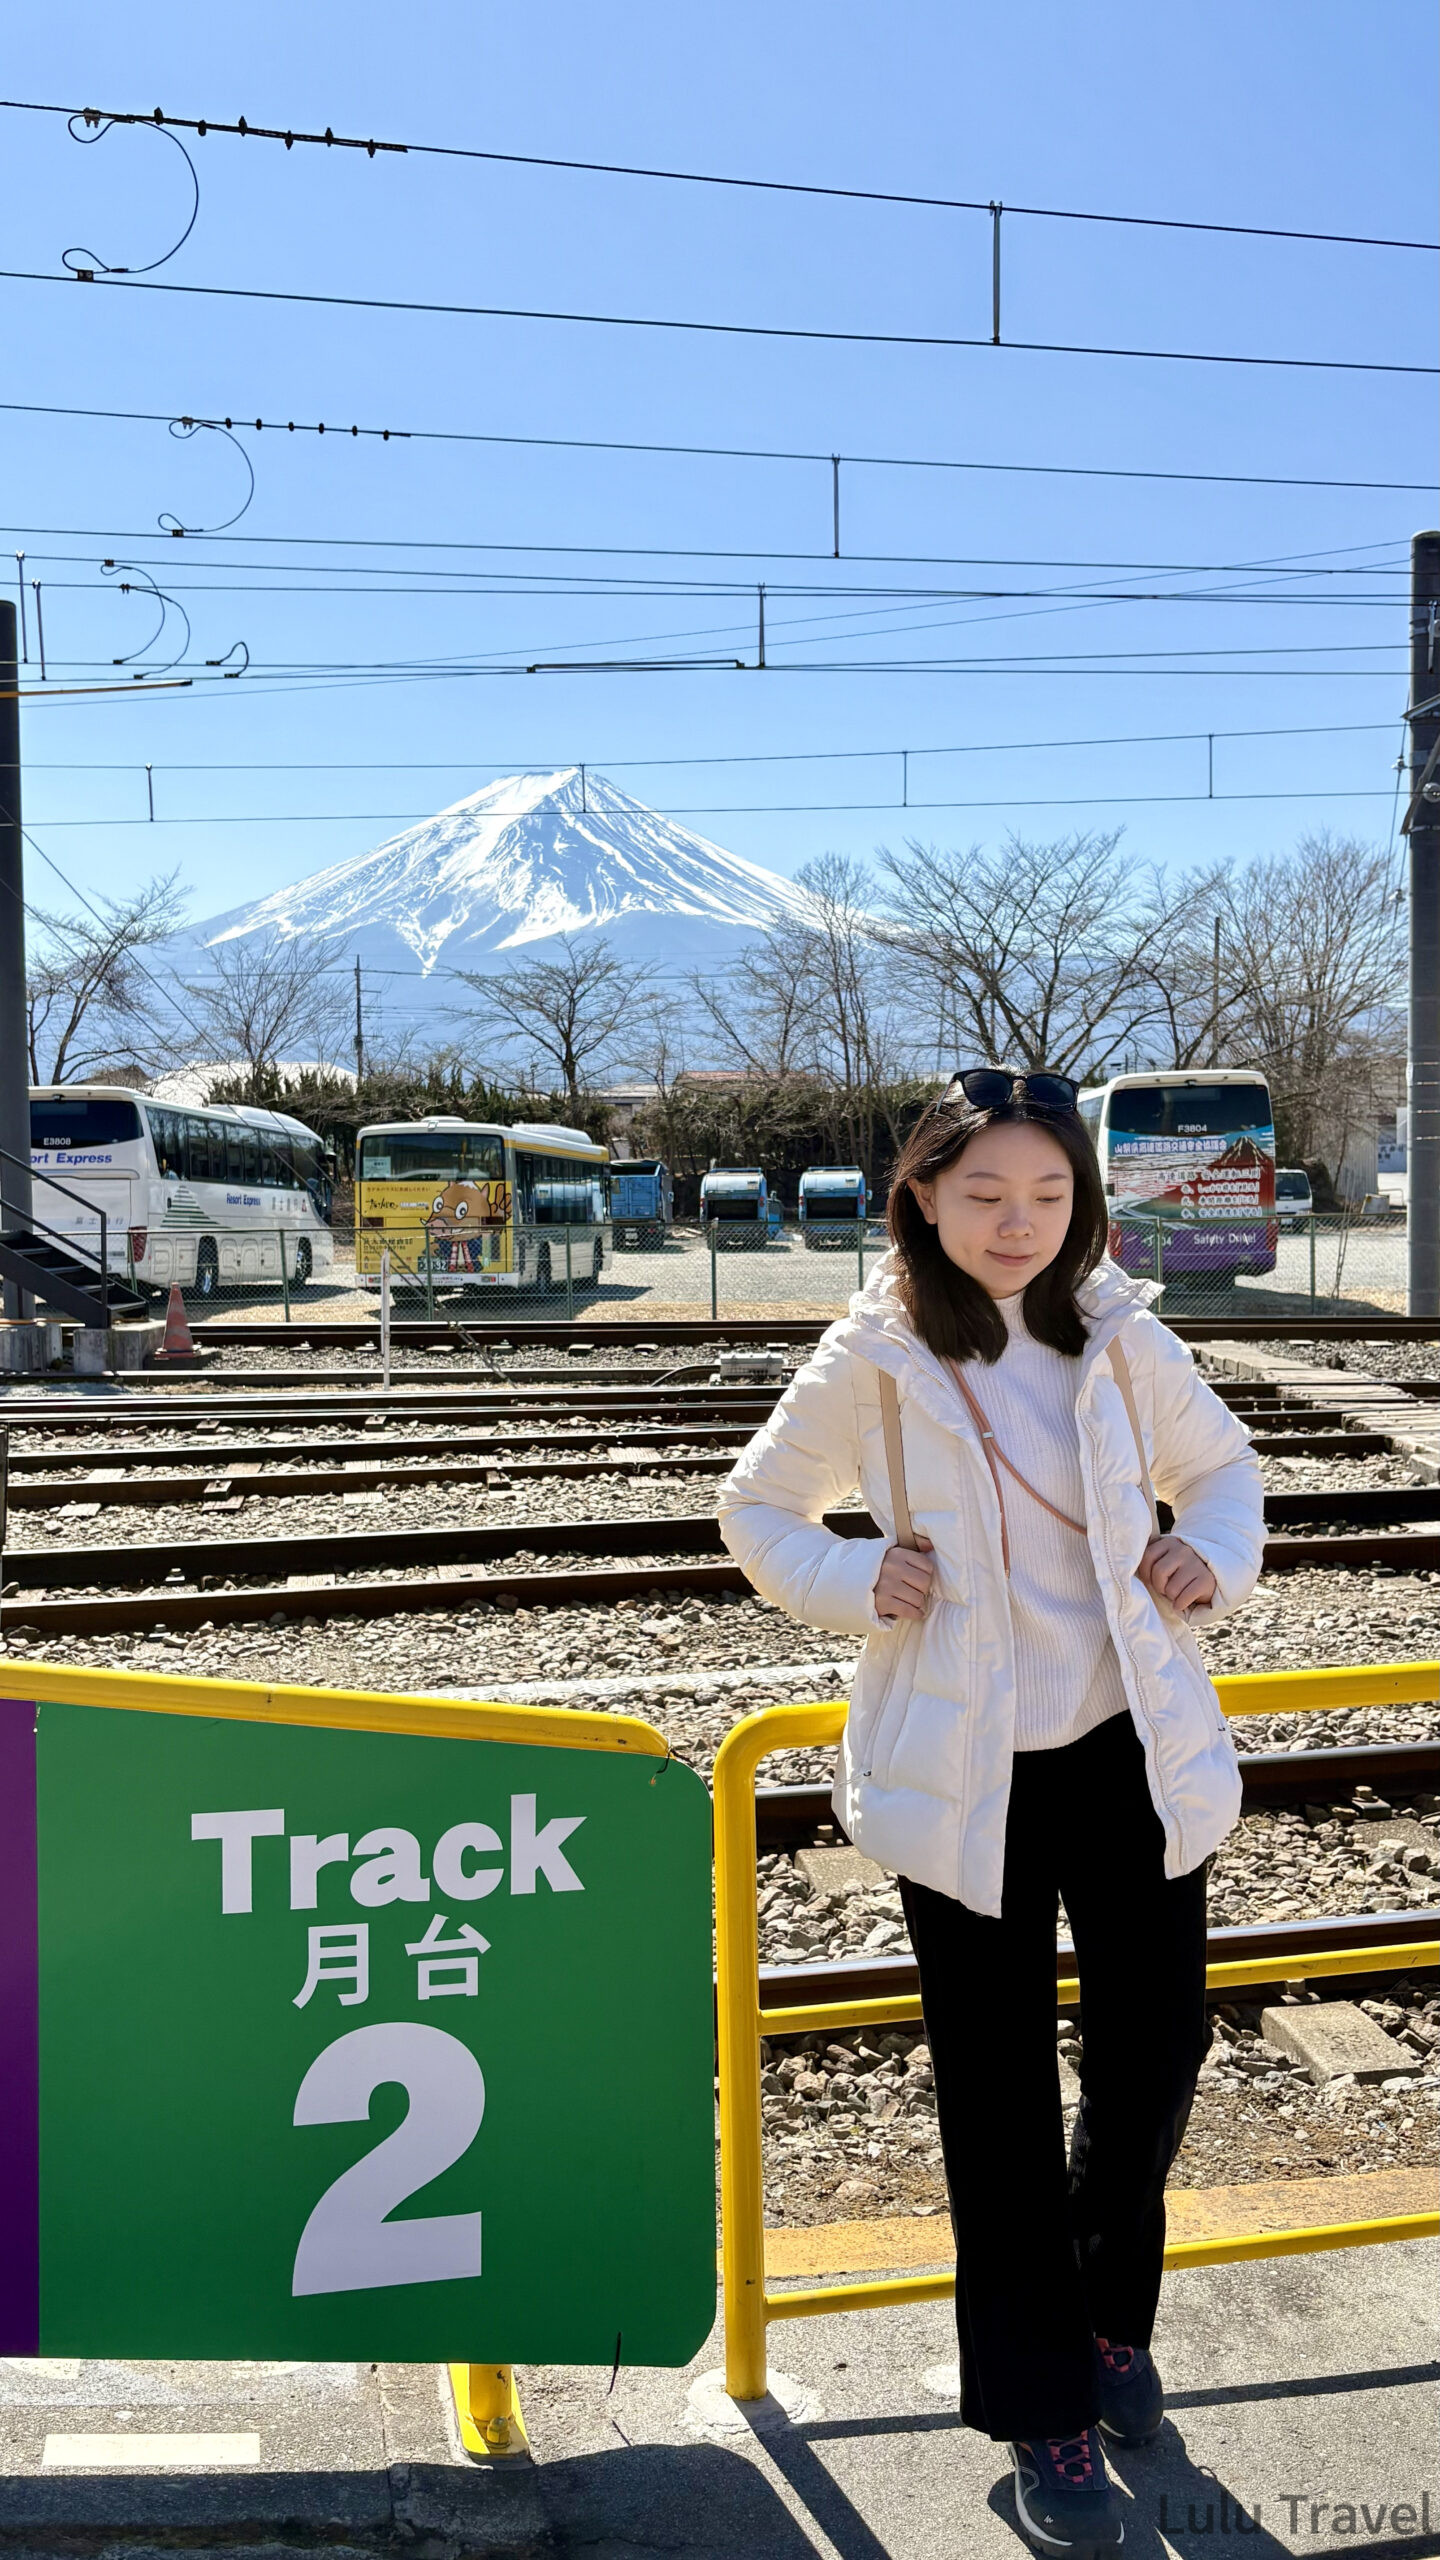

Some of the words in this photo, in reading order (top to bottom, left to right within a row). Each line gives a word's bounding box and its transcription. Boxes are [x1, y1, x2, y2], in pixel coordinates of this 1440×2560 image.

[1177, 1124, 1208, 1133] F3804
[43, 1137, 72, 1146] E3808
[56, 1152, 112, 1166] Express
[226, 1192, 242, 1205] Resort
[243, 1194, 261, 1207] Express
[191, 1793, 587, 1914] Track
[292, 1914, 491, 2010] 月台
[292, 2022, 486, 2297] 2
